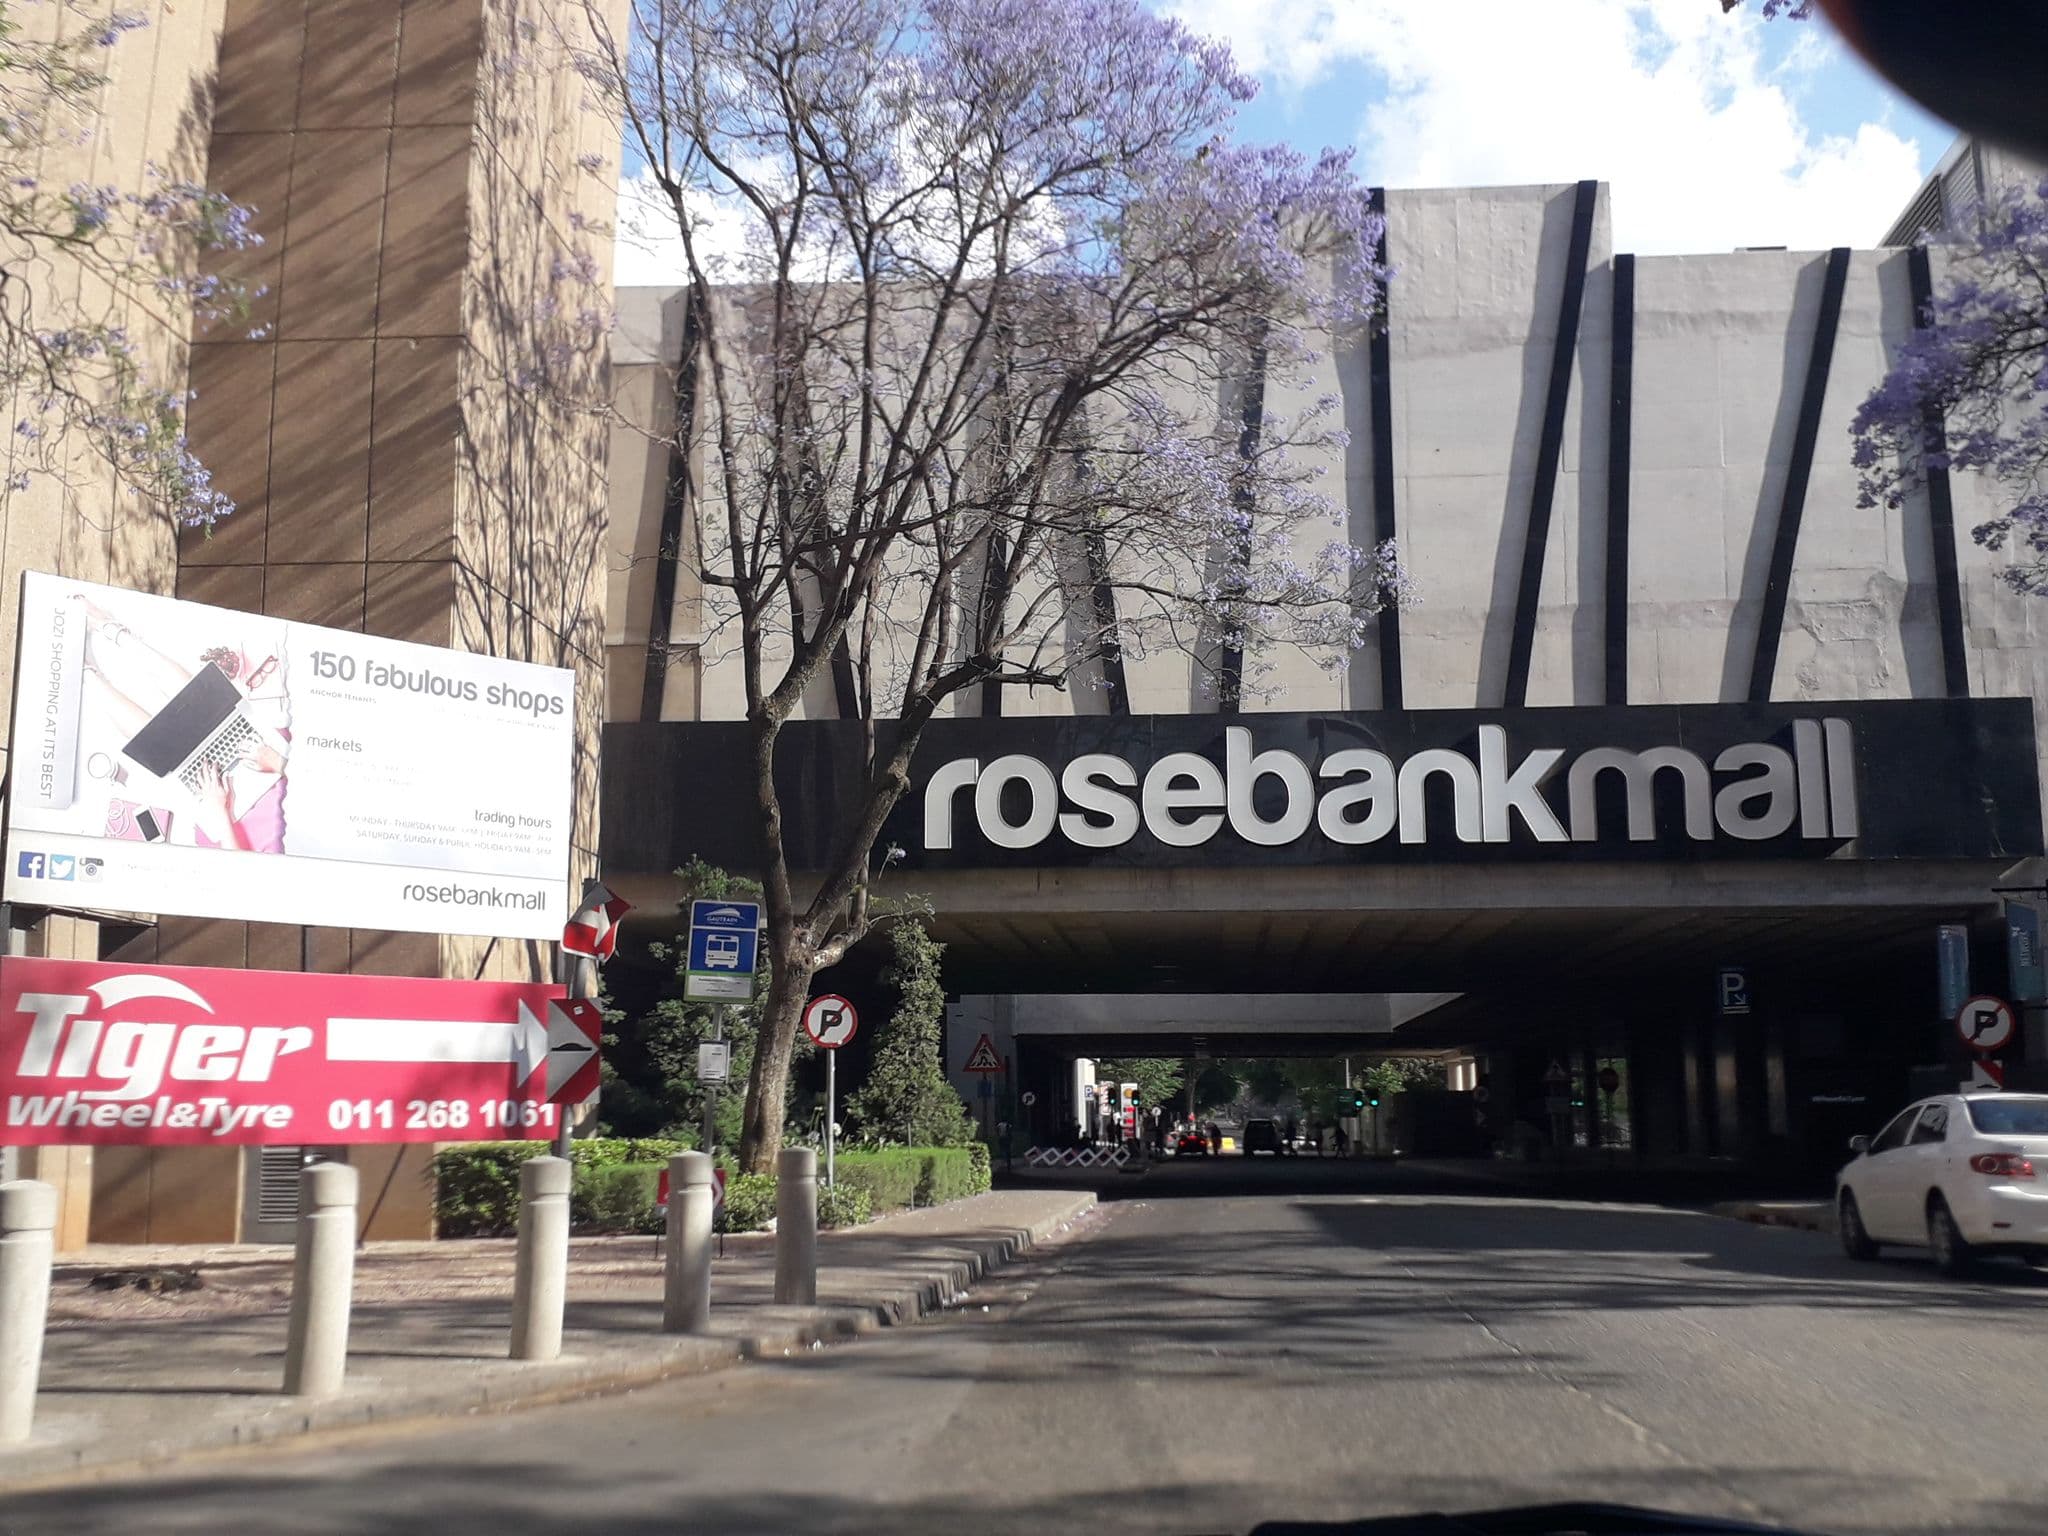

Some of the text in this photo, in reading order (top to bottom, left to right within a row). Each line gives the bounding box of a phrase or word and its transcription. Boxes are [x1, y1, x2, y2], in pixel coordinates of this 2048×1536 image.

[309, 649, 565, 719] 150 fabulous shops
[40, 607, 66, 800] JOZI SHOPPING AT ITS BEST
[306, 735, 363, 753] markets
[922, 717, 1859, 850] rosebankmall
[474, 808, 552, 829] trading hours
[403, 833, 437, 845] SUNDAY
[402, 881, 547, 913] rosebankmall
[15, 976, 313, 1101] Tiger
[819, 1009, 843, 1037] P
[1973, 1009, 1998, 1040] P
[7, 1090, 294, 1137] Wheel&Tyre
[328, 1098, 555, 1130] 011 268 1061
